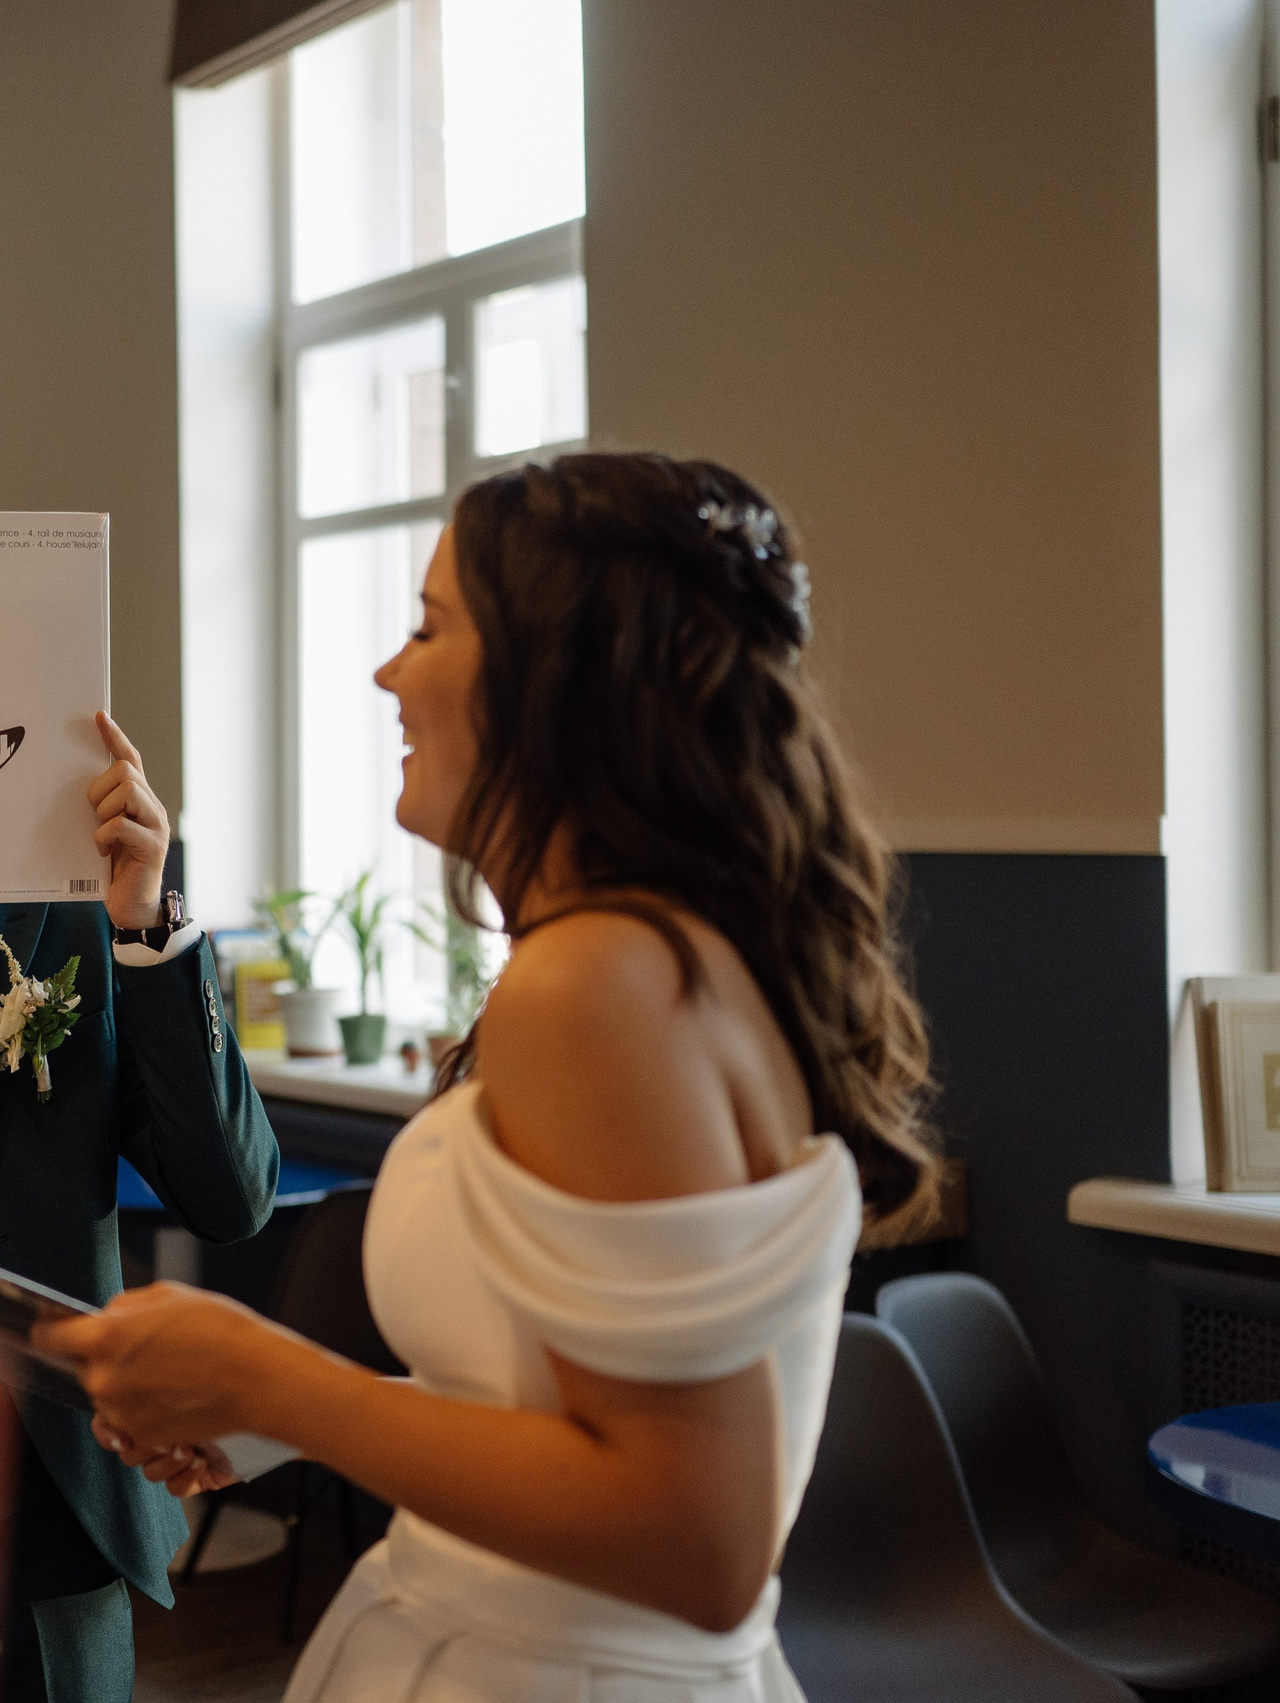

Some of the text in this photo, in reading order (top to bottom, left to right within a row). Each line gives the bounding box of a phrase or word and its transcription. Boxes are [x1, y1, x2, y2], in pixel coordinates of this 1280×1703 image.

[27, 529, 35, 538] 4.
[37, 529, 51, 538] rail
[51, 529, 64, 538] de
[66, 529, 102, 539] musique
[37, 540, 45, 549] 4.
